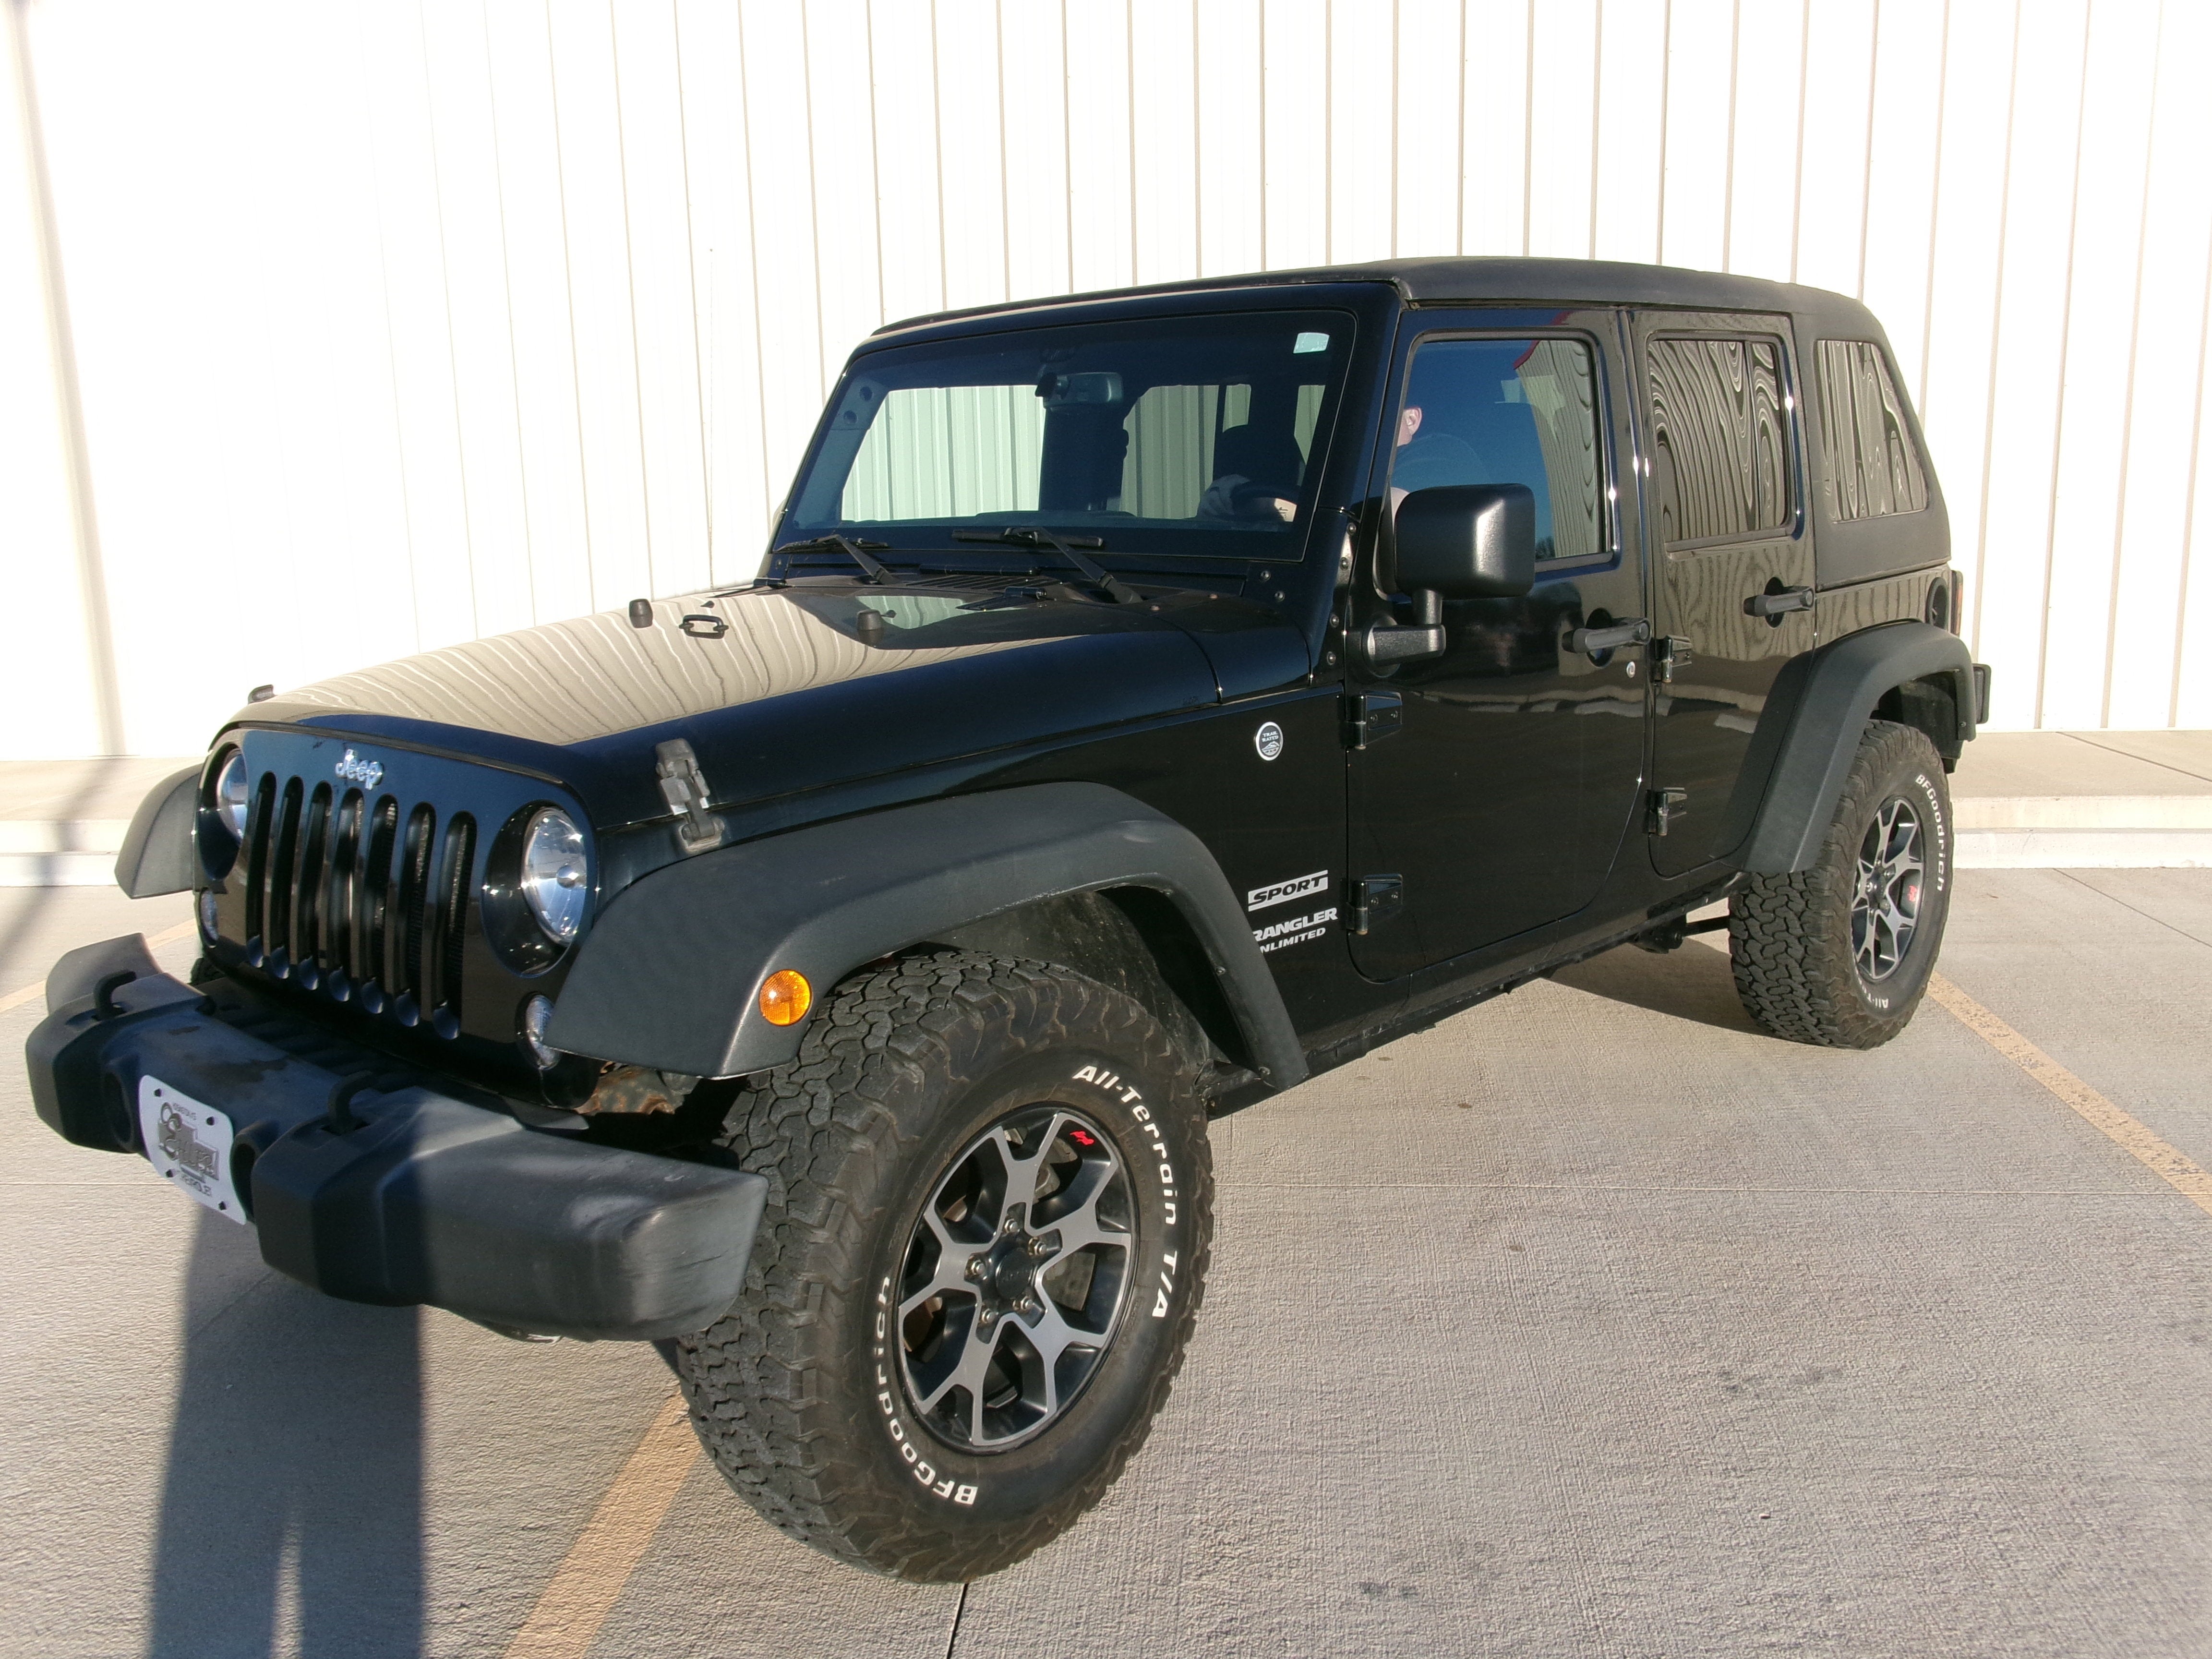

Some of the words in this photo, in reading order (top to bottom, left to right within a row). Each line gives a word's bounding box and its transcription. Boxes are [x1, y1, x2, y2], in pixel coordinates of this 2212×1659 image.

[335, 749, 383, 790] Jeep
[1915, 774, 1946, 891] BFGoodrich
[1249, 874, 1328, 906] SPORT
[1252, 907, 1338, 942] RANGLER
[1260, 927, 1326, 953] NLIMITED
[1072, 1065, 1178, 1225] All-Terrain
[1152, 1250, 1177, 1318] T/A
[874, 1276, 978, 1505] BFGoodrich
